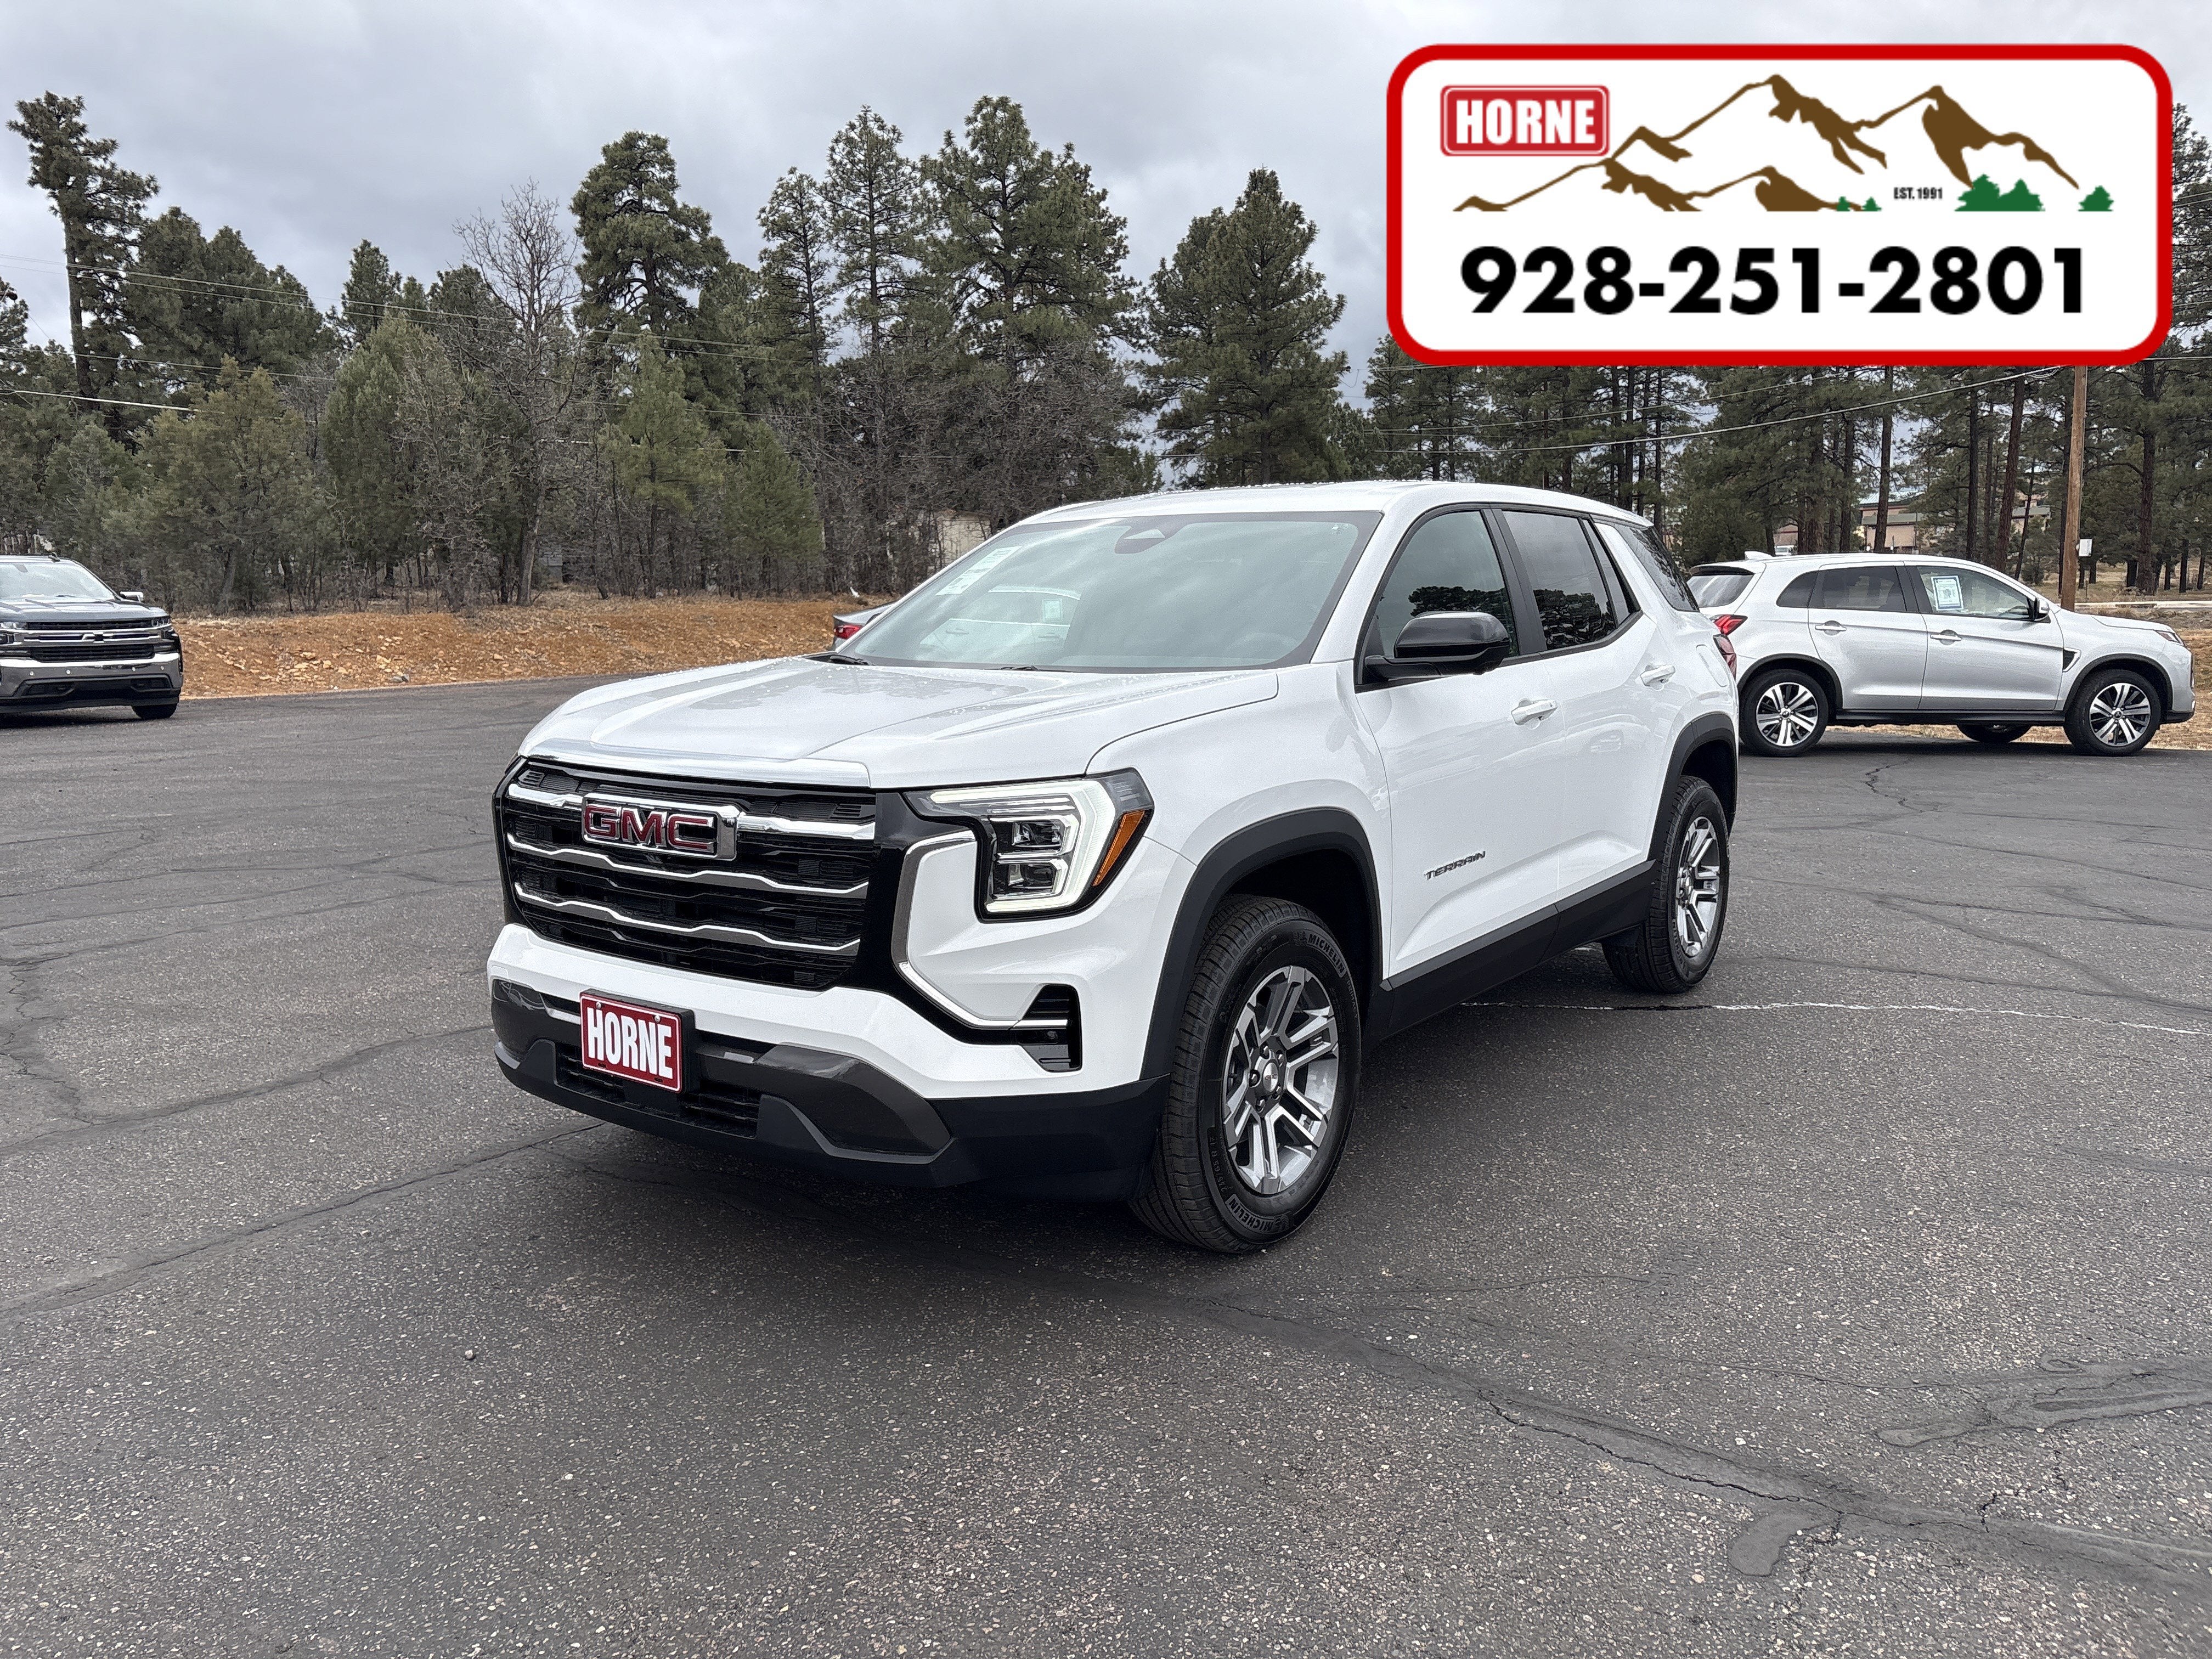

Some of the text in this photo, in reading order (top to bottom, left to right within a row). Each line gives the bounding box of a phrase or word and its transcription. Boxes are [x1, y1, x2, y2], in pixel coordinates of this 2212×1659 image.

[584, 803, 718, 853] GMC
[1424, 850, 1486, 880] TERRAIN
[1308, 933, 1345, 974] MICHELIN
[587, 1007, 674, 1079] HORNE
[1228, 1197, 1274, 1232] MICHELIN
